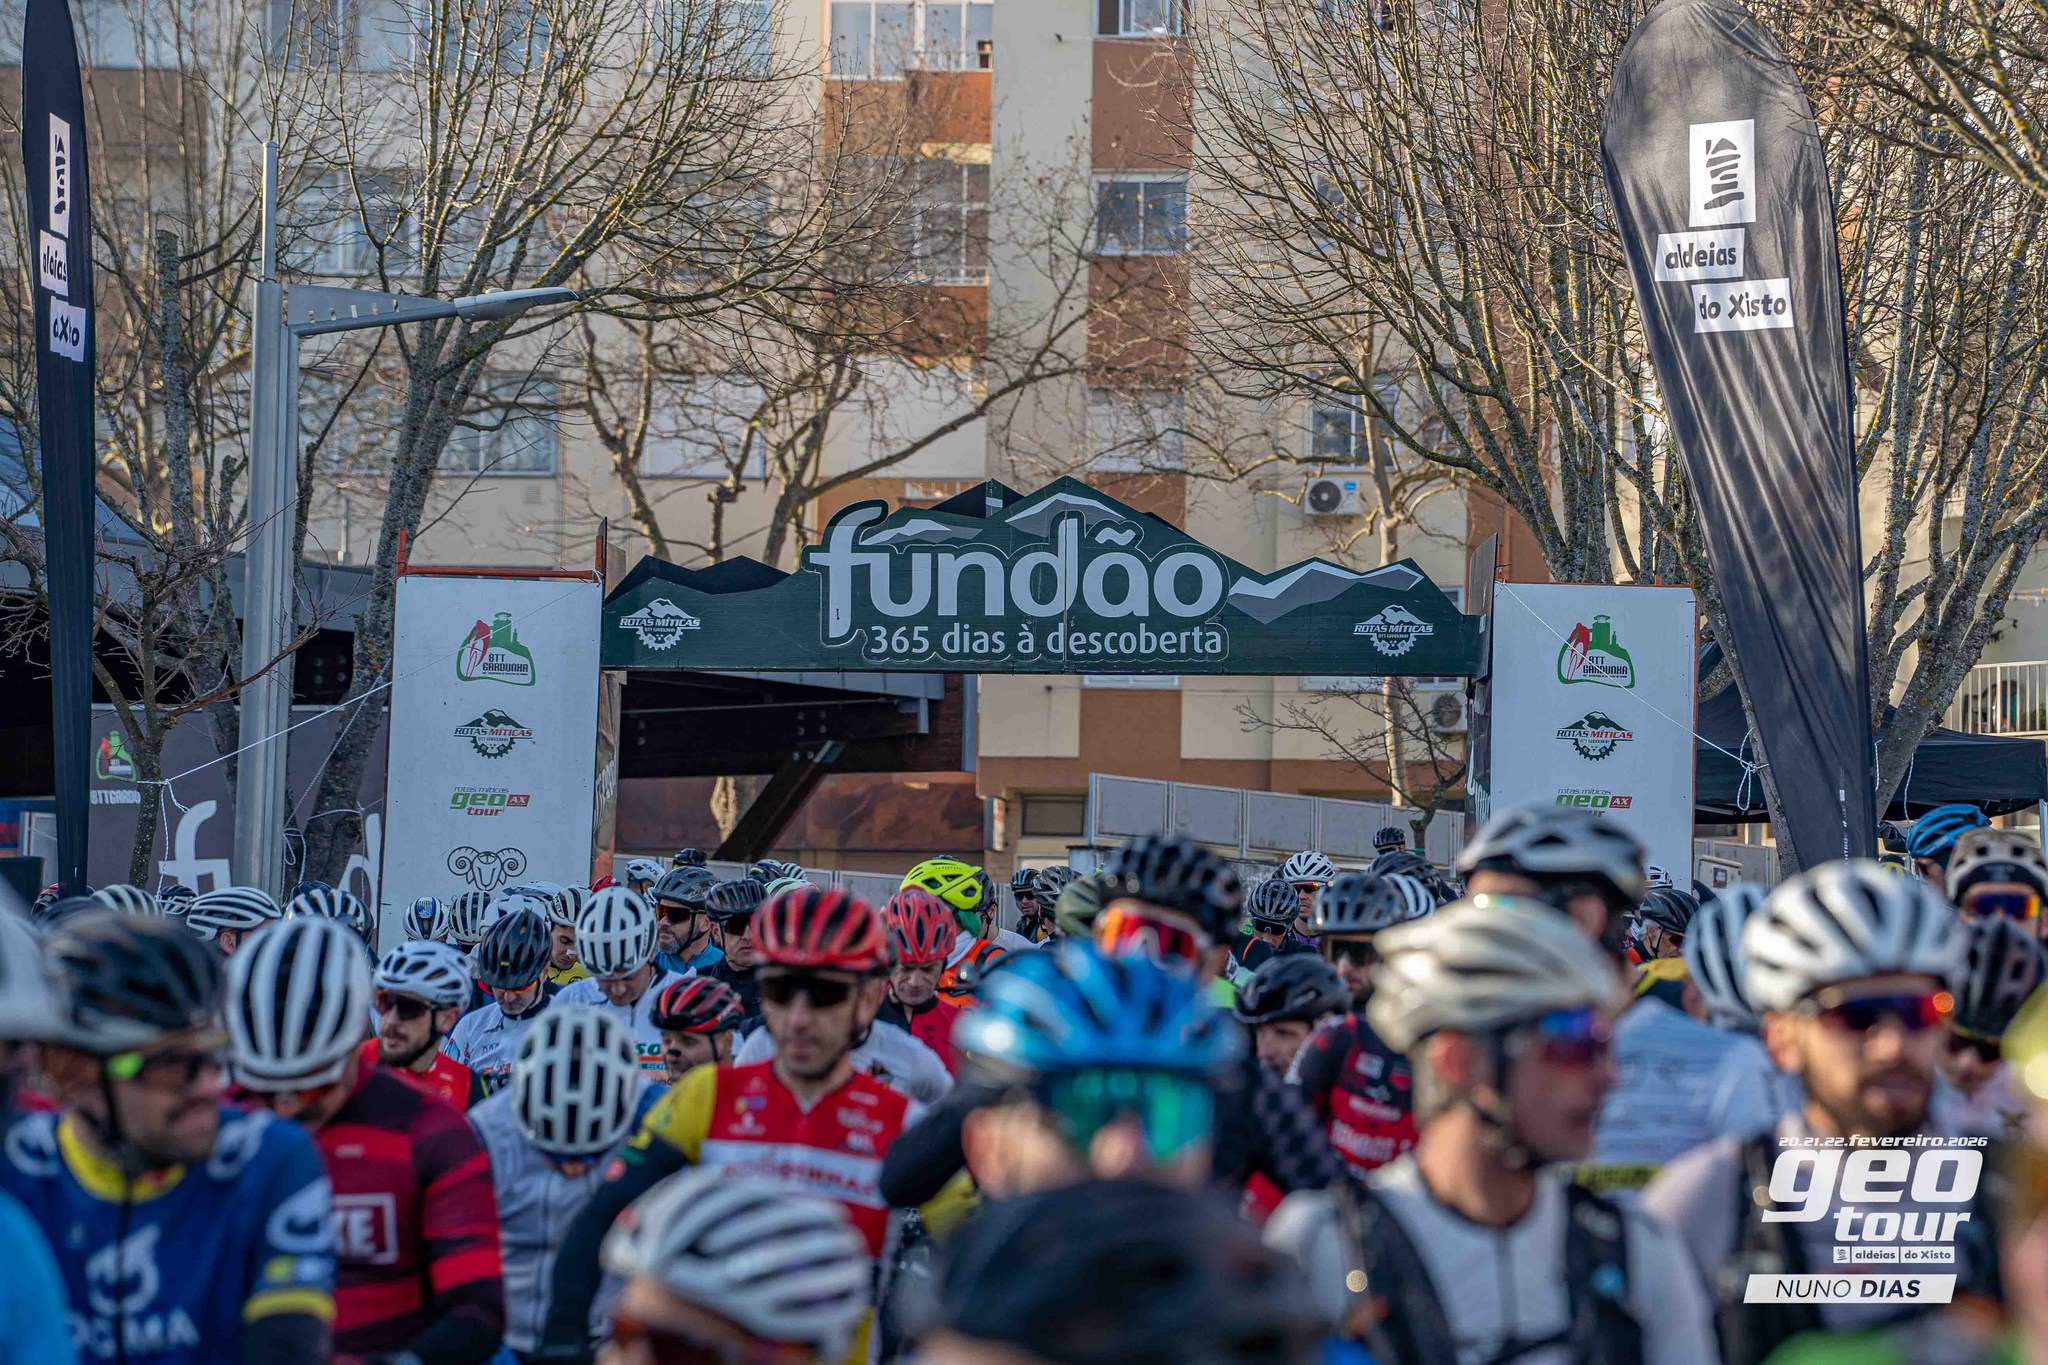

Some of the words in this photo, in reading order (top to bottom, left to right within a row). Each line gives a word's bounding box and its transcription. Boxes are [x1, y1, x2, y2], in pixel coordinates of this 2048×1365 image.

[1665, 241, 1737, 270] aldeias
[1699, 294, 1721, 320] do
[1727, 291, 1787, 320] Xisto
[809, 506, 1223, 639] fundão
[620, 618, 654, 627] ROTAS
[655, 617, 701, 627] MÍTICAS
[1354, 624, 1388, 633] ROTAS
[1388, 623, 1434, 633] MÍTICAS
[870, 625, 930, 654] 365
[942, 622, 1006, 654] dias
[1017, 624, 1034, 654] à
[1046, 622, 1222, 654] descoberta
[488, 653, 506, 662] BTT
[1588, 655, 1606, 665] BTT
[482, 662, 528, 673] GARDUNHA
[1583, 664, 1628, 675] GARDUNHA
[454, 727, 487, 736] ROTAS
[488, 727, 533, 737] MÍTICAS
[1557, 729, 1589, 738] ROTAS
[1590, 729, 1634, 739] MÍTICAS
[450, 792, 507, 810] geo
[509, 796, 528, 804] AX
[1612, 797, 1629, 805] AX
[466, 806, 503, 816] tour
